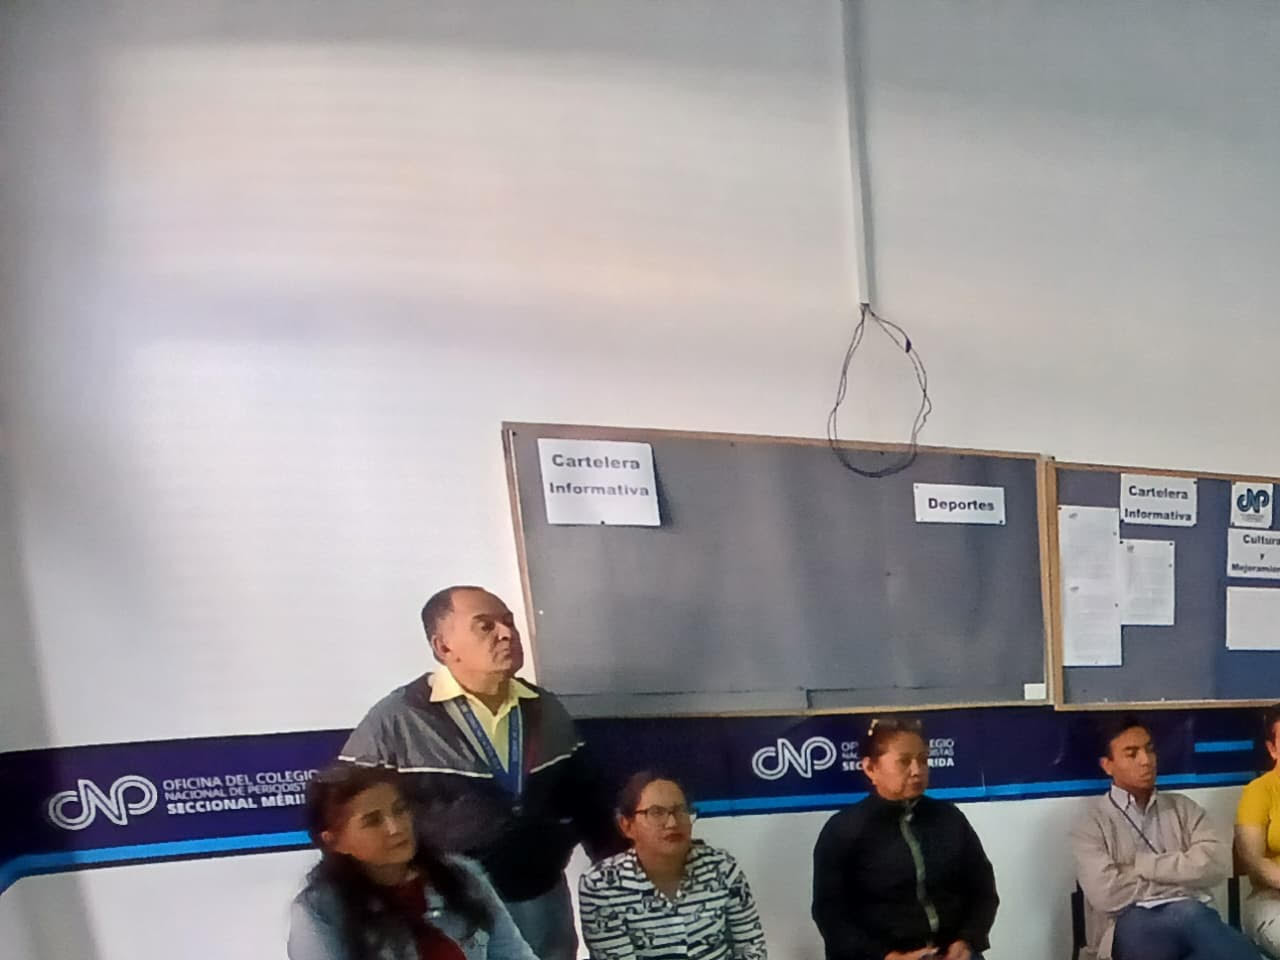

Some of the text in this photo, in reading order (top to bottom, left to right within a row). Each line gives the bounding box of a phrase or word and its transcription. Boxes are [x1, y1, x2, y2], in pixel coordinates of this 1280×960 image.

[552, 453, 641, 470] Cartelera
[549, 482, 650, 497] Informativa
[1128, 485, 1189, 500] Cartelera
[928, 497, 995, 512] Deportes
[1124, 507, 1192, 521] Informativa
[162, 776, 223, 792] OFICINA
[224, 774, 254, 788] DEL
[164, 782, 307, 801] NACIONAL DE PERIODIST
[166, 797, 259, 815] SECCIONAL
